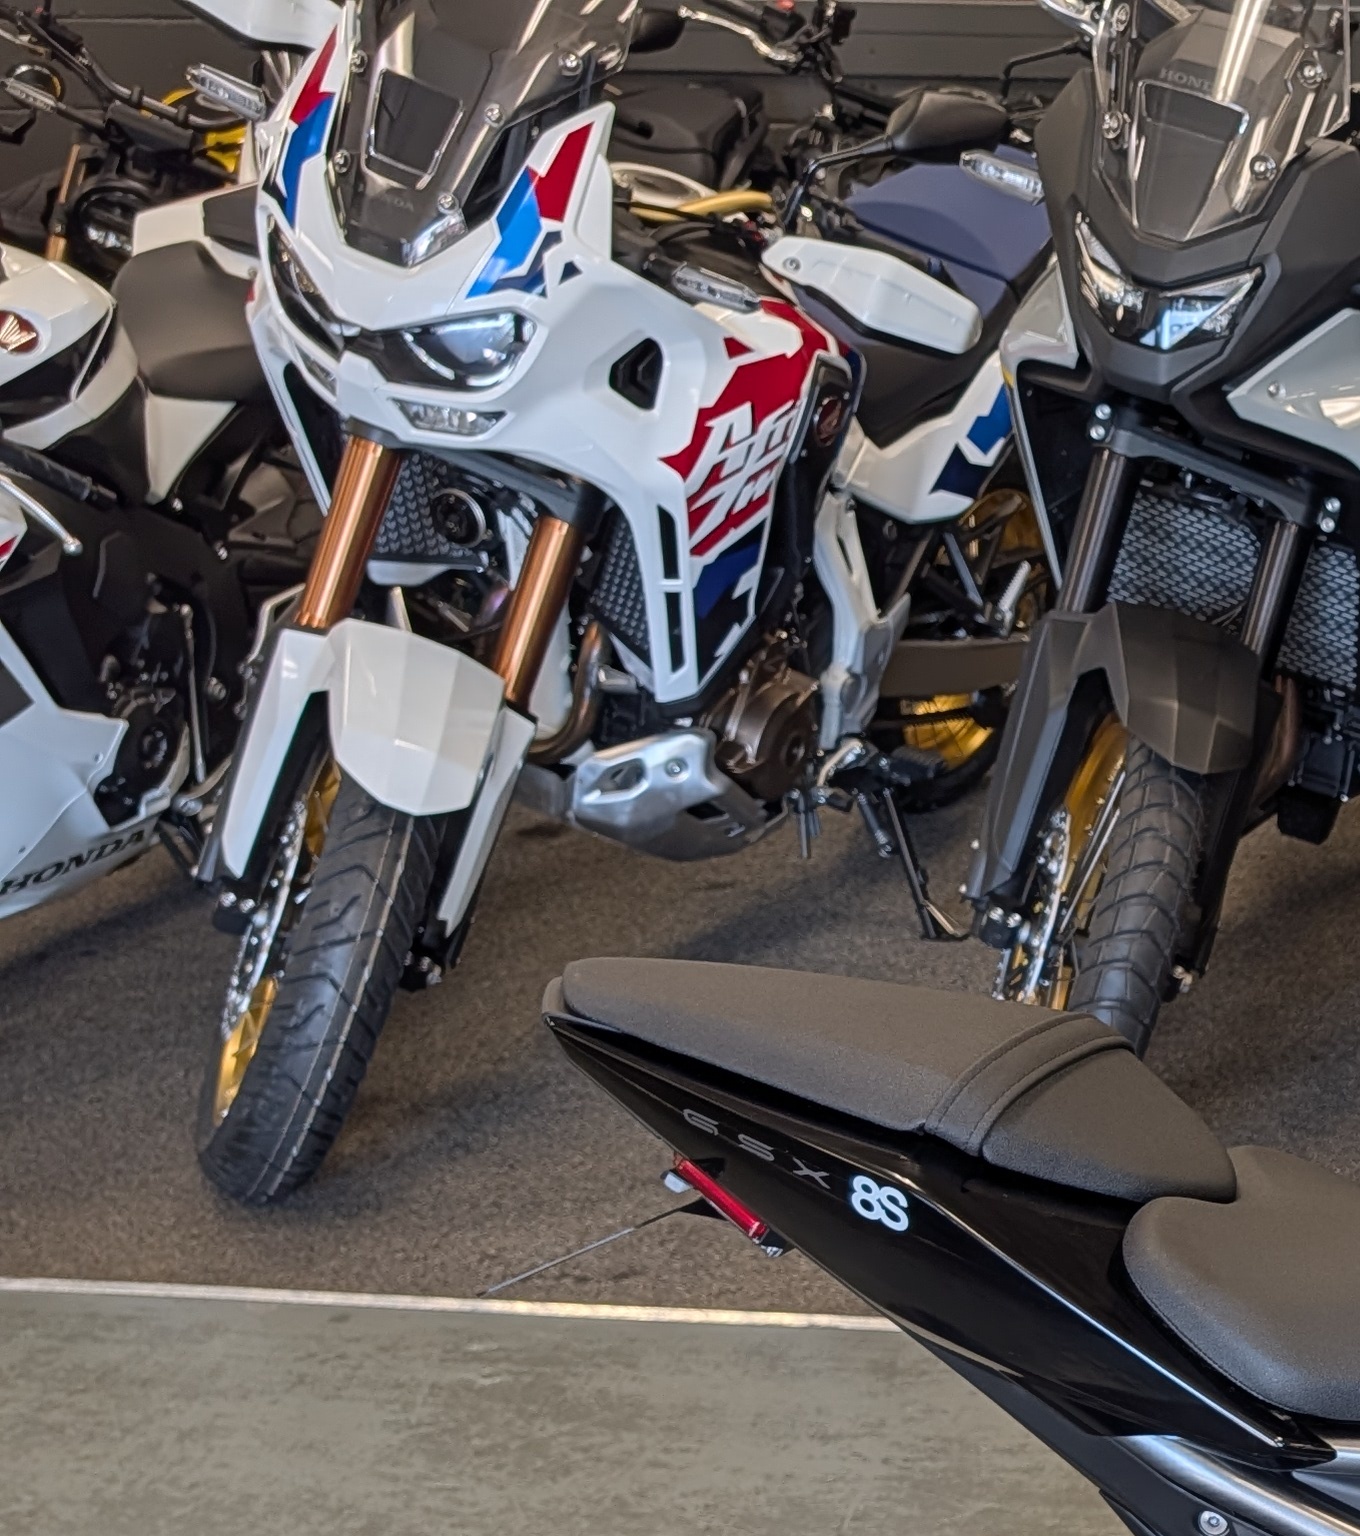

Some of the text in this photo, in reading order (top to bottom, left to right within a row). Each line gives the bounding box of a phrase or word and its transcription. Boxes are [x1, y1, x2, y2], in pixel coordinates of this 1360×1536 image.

[0, 830, 145, 896] HONDA
[682, 1108, 910, 1232] GSX 8S
